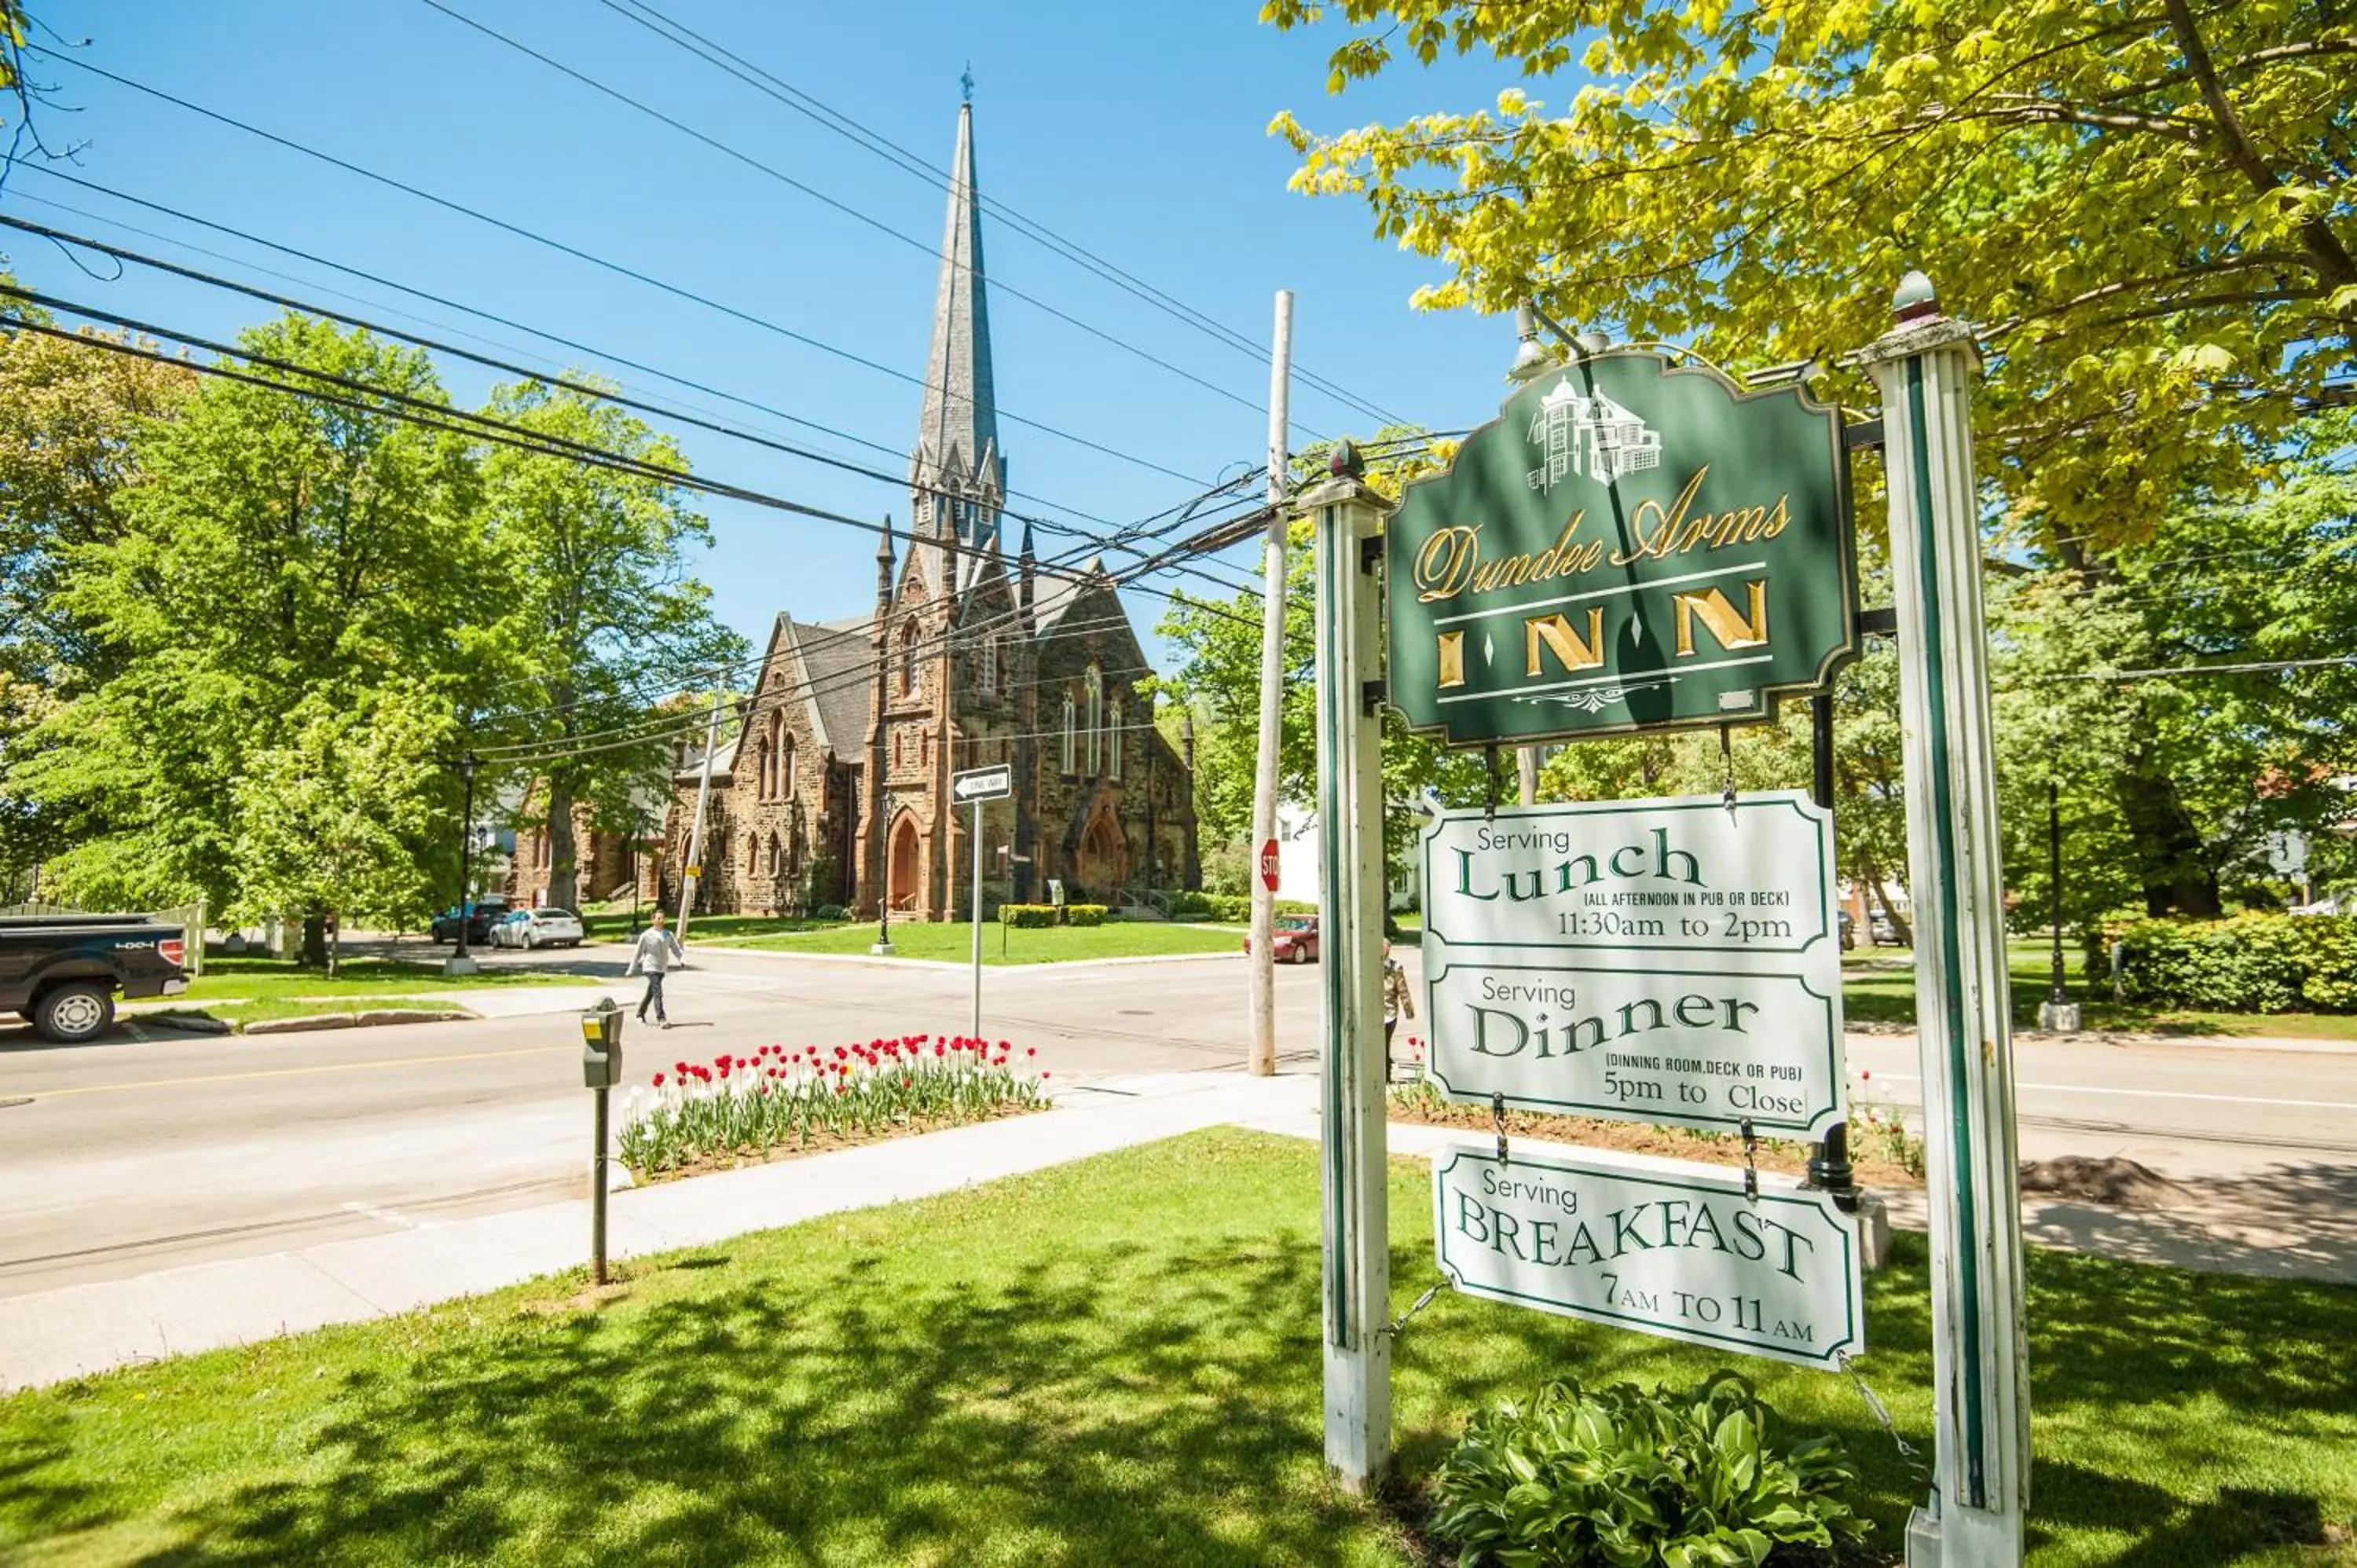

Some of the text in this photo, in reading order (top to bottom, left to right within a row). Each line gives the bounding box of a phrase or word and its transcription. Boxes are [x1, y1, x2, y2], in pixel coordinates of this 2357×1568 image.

[1414, 463, 1792, 603] Dundee Arms
[1478, 825, 1570, 853] Serving
[1262, 854, 1279, 876] STO
[1450, 827, 1708, 902] Lunch
[1584, 891, 1790, 906] (ALL AFTERNOON IN PUB OR DECK)
[1558, 912, 1791, 943] 11:30am to 2pm
[1483, 976, 1575, 1011] Serving
[1464, 994, 1760, 1059] Dinner
[1606, 1053, 1660, 1069] (DINNING
[1747, 1064, 1764, 1079] OR
[1770, 1066, 1802, 1082] PUB)
[1604, 1072, 1803, 1114] 5pm to Close
[1483, 1168, 1578, 1214] Serving
[1453, 1186, 1814, 1284] BREAKFAST
[1673, 1291, 1721, 1322] TO
